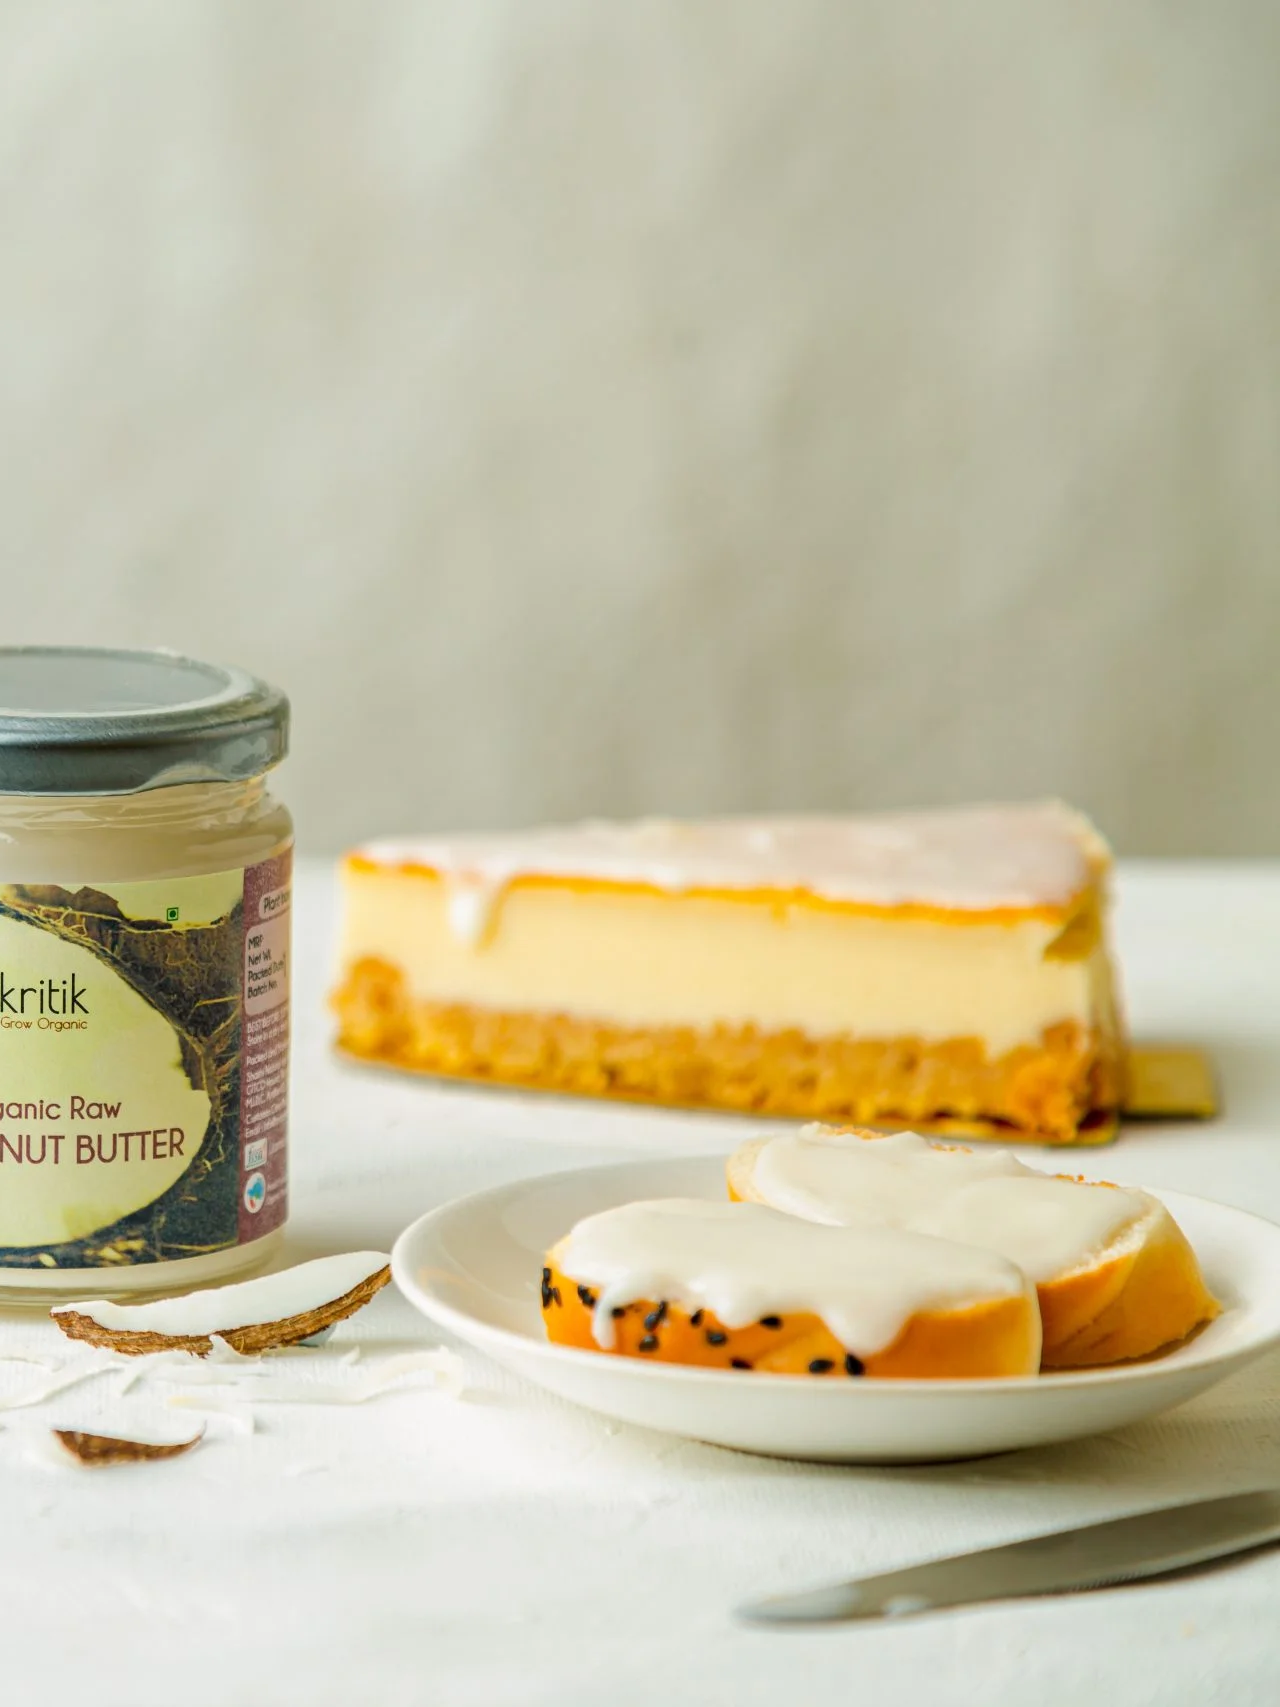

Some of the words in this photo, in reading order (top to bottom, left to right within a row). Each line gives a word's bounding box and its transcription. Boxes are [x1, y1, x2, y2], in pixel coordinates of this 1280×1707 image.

[0, 1016, 33, 1030] Grow
[37, 1017, 88, 1033] Organic
[70, 1095, 122, 1120] Raw
[75, 1127, 186, 1165] BUTTER
